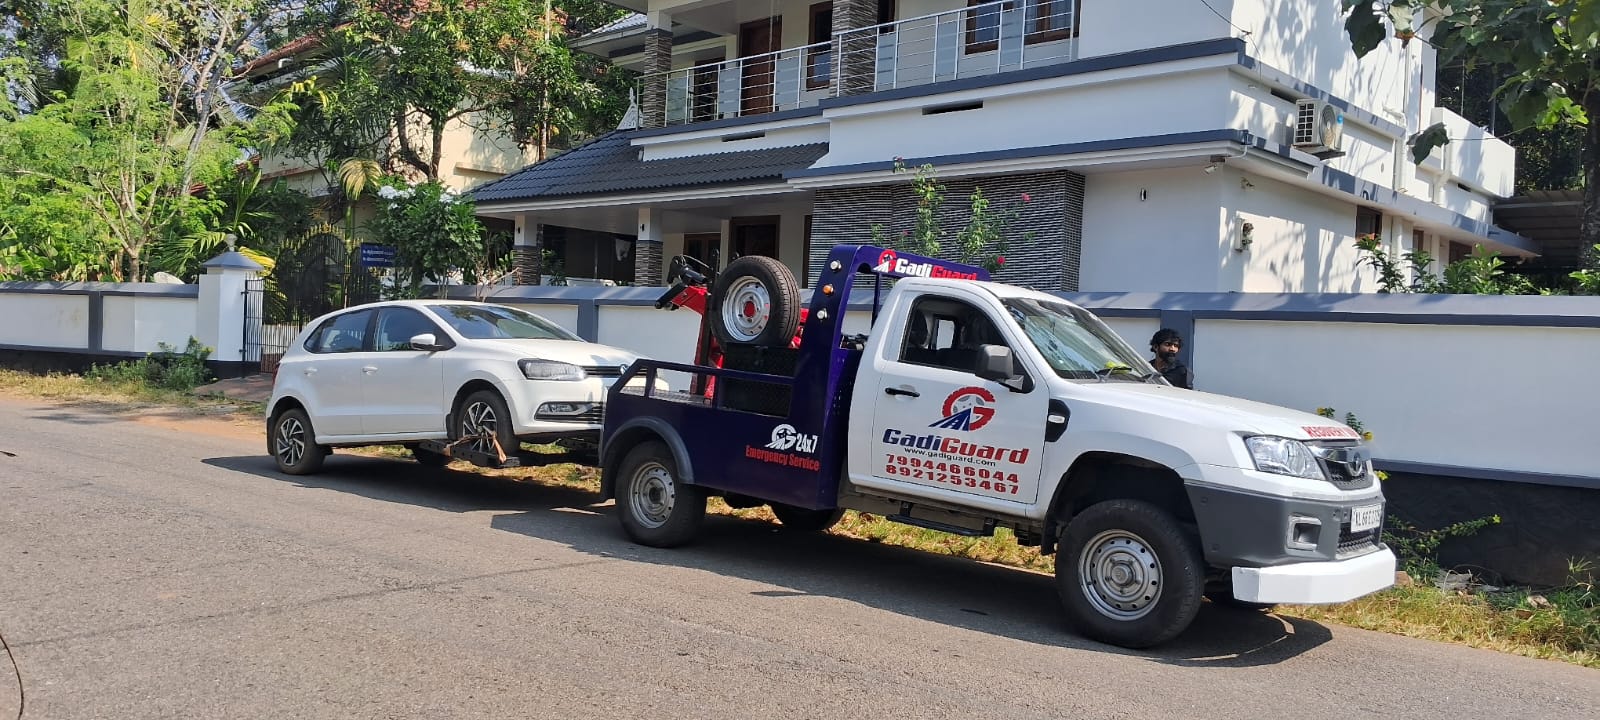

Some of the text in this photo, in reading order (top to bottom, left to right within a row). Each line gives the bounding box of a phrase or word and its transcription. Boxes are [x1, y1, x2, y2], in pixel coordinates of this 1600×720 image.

[894, 258, 978, 280] GadiGuard
[795, 433, 819, 453] 24x7
[882, 428, 1030, 464] GadiGuard
[745, 445, 820, 472] Emergency Service
[886, 453, 1019, 484] 7994466044
[904, 447, 996, 467] www.gadiguard.com
[885, 464, 1019, 495] 8921253467
